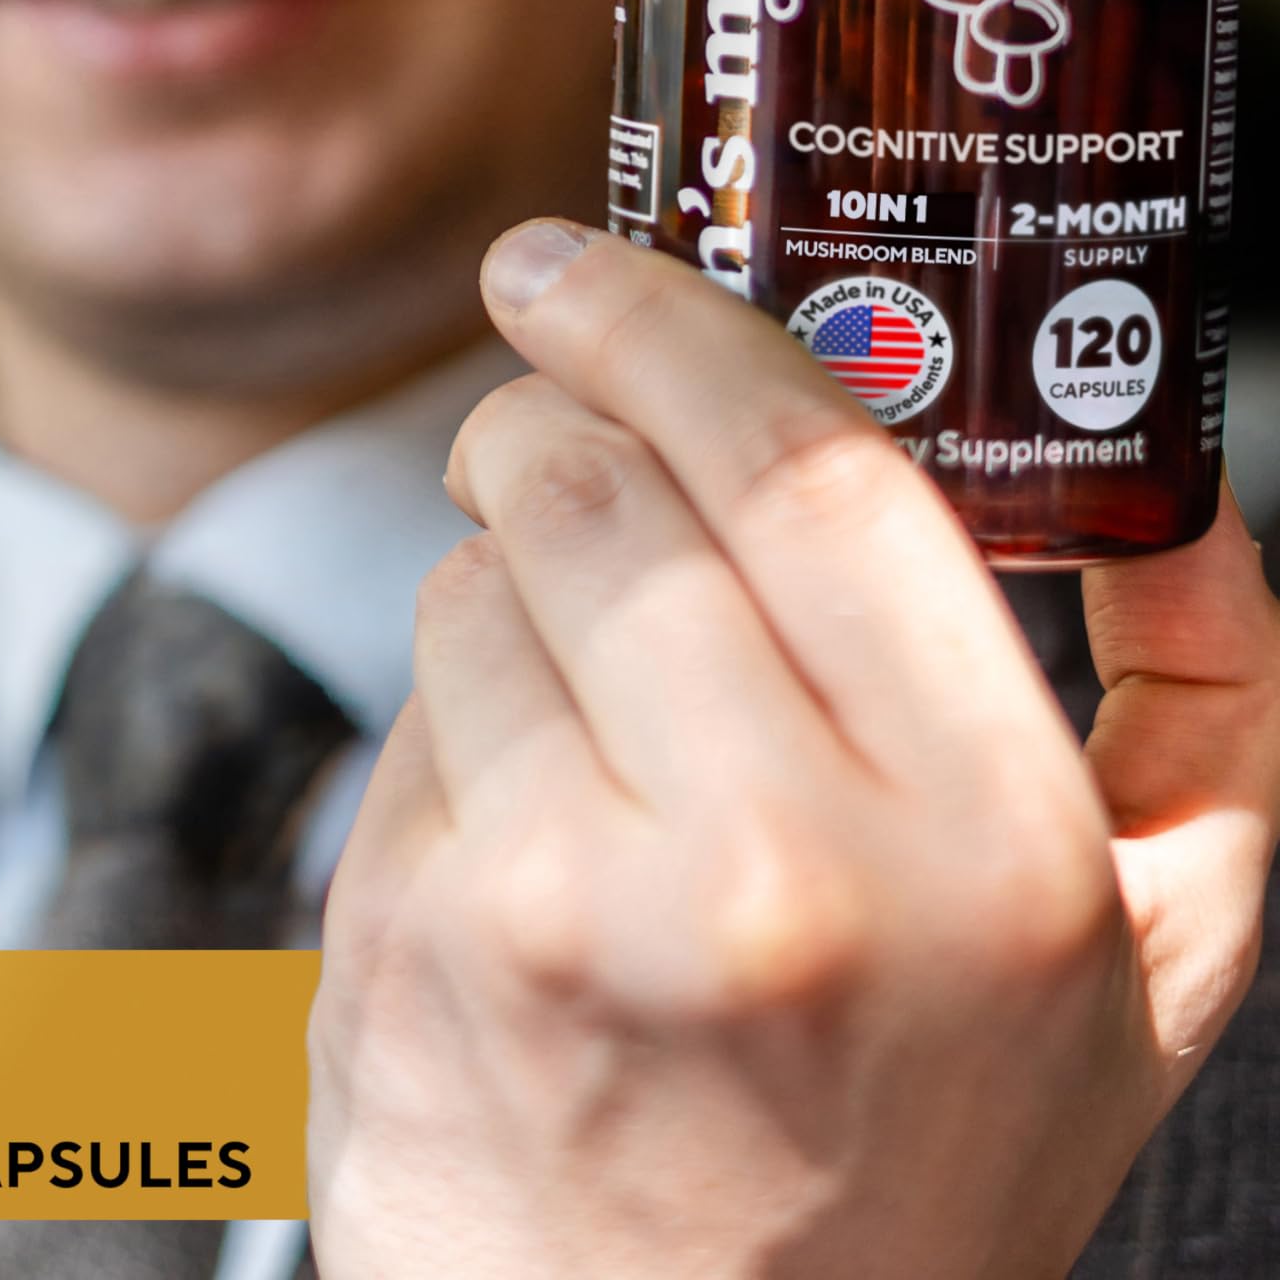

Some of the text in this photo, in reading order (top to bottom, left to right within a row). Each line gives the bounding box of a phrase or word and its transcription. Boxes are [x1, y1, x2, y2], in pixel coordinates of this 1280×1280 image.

[788, 121, 1183, 164] COGNITIVE SUPPORT
[1009, 196, 1187, 236] 2-MONTH
[785, 239, 977, 266] MUSHROOM BLEND
[1063, 245, 1149, 267] SUPPLY
[800, 281, 935, 328] Made in USA
[1049, 314, 1152, 369] 120
[1049, 378, 1146, 399] CAPSULES
[936, 430, 1145, 475] Supplement
